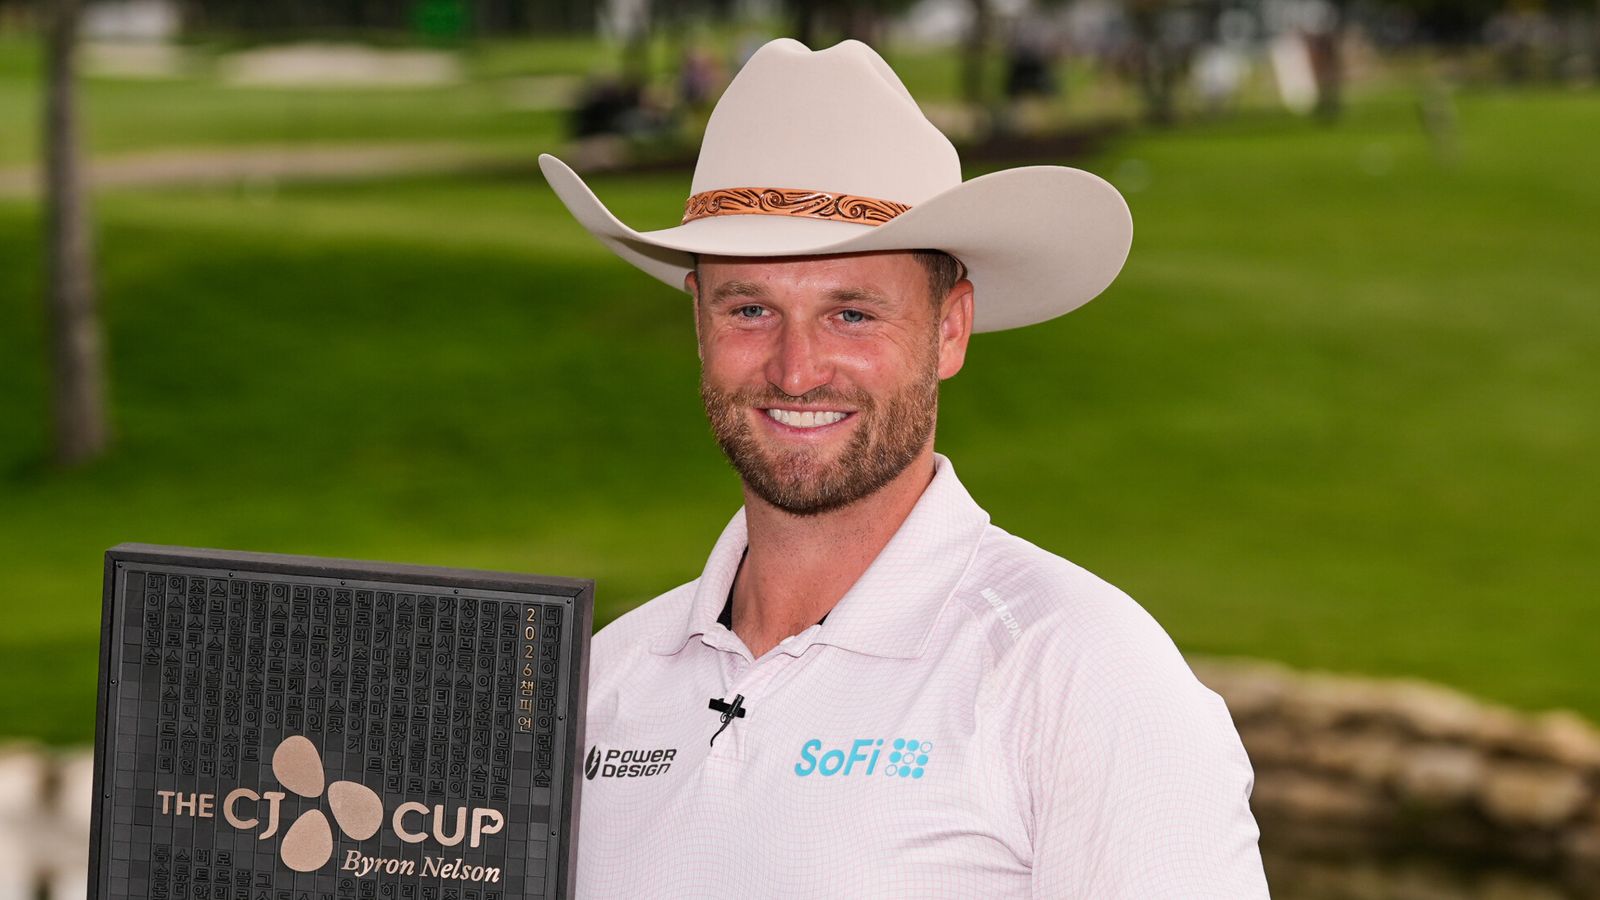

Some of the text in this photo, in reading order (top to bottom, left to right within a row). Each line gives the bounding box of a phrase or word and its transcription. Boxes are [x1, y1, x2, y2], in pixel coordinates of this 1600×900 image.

[267, 586, 287, 728] 이스트우드크레이
[517, 608, 536, 732] 2026챔피언
[794, 738, 884, 777] SoFi
[157, 787, 504, 848] THE CJ CUP
[341, 849, 501, 883] Byron Nelson
